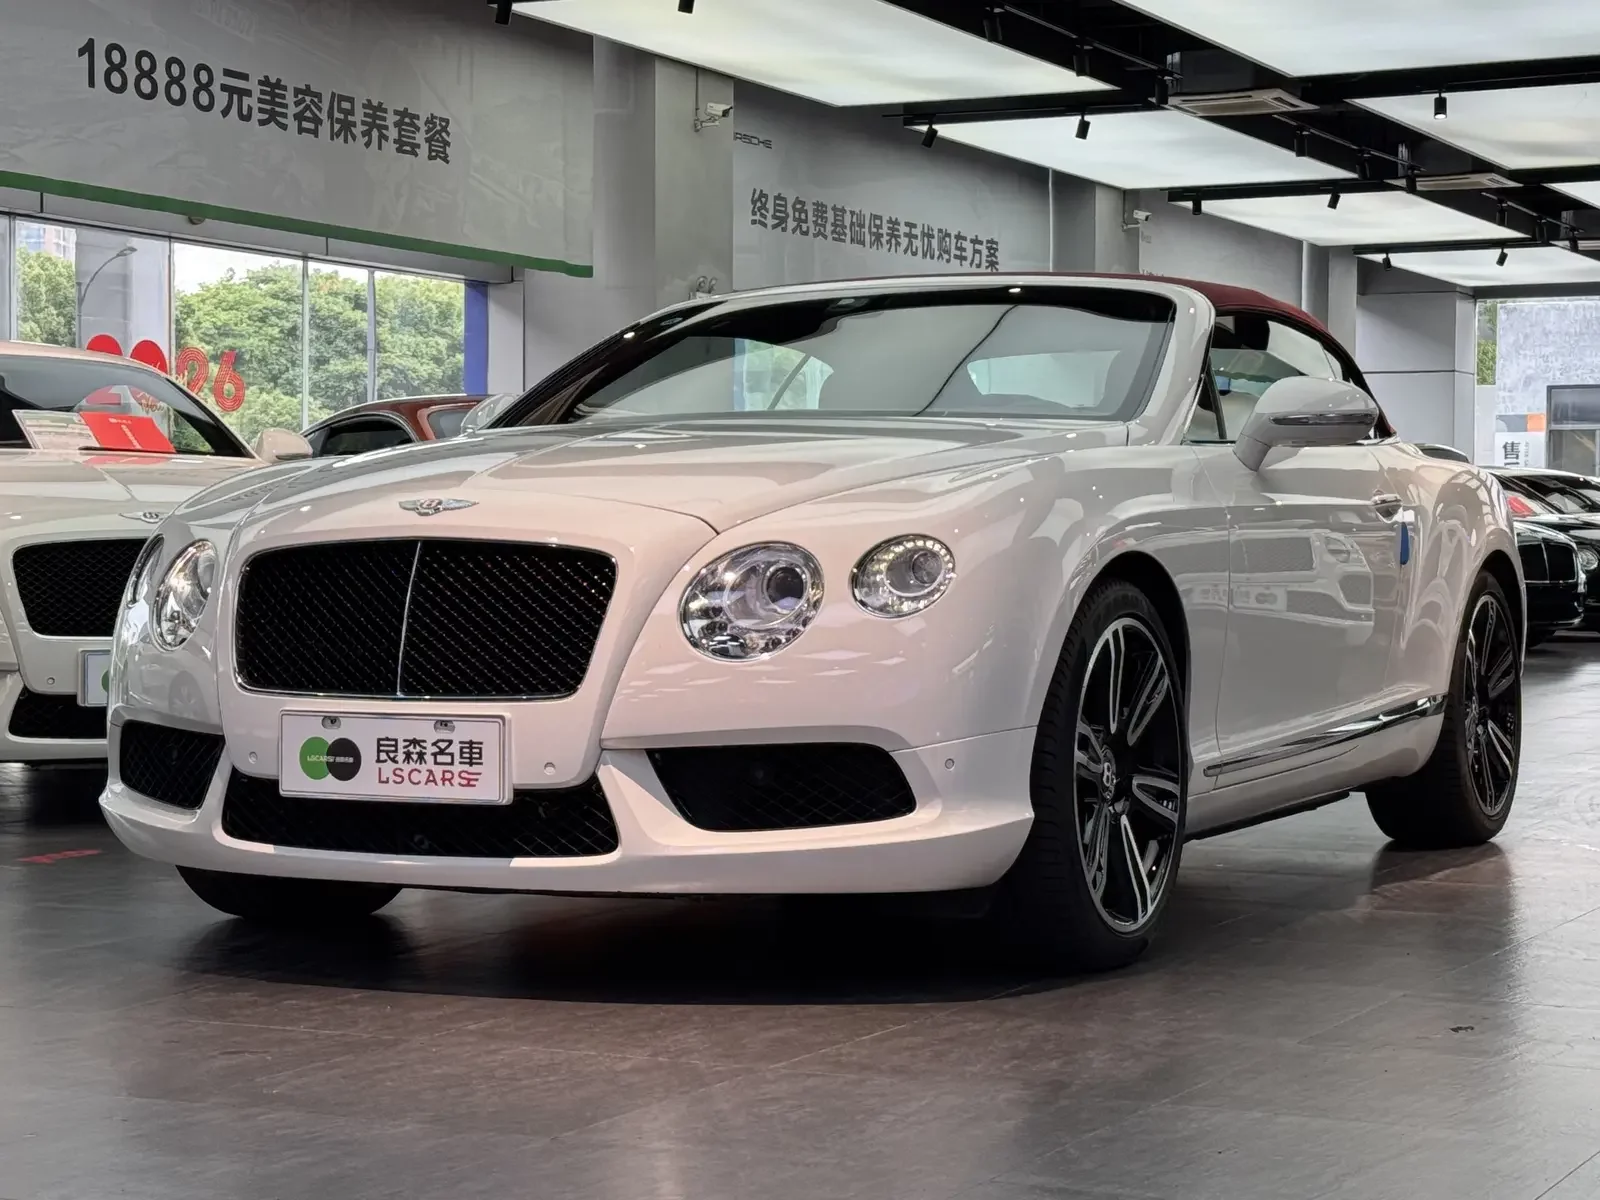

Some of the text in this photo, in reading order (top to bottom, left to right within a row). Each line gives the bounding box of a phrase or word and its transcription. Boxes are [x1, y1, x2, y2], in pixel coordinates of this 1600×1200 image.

[78, 37, 451, 164] 18888元美容保养套餐
[750, 187, 999, 272] 终身免费基础保养无忧购车方案
[375, 737, 484, 767] 良森名車
